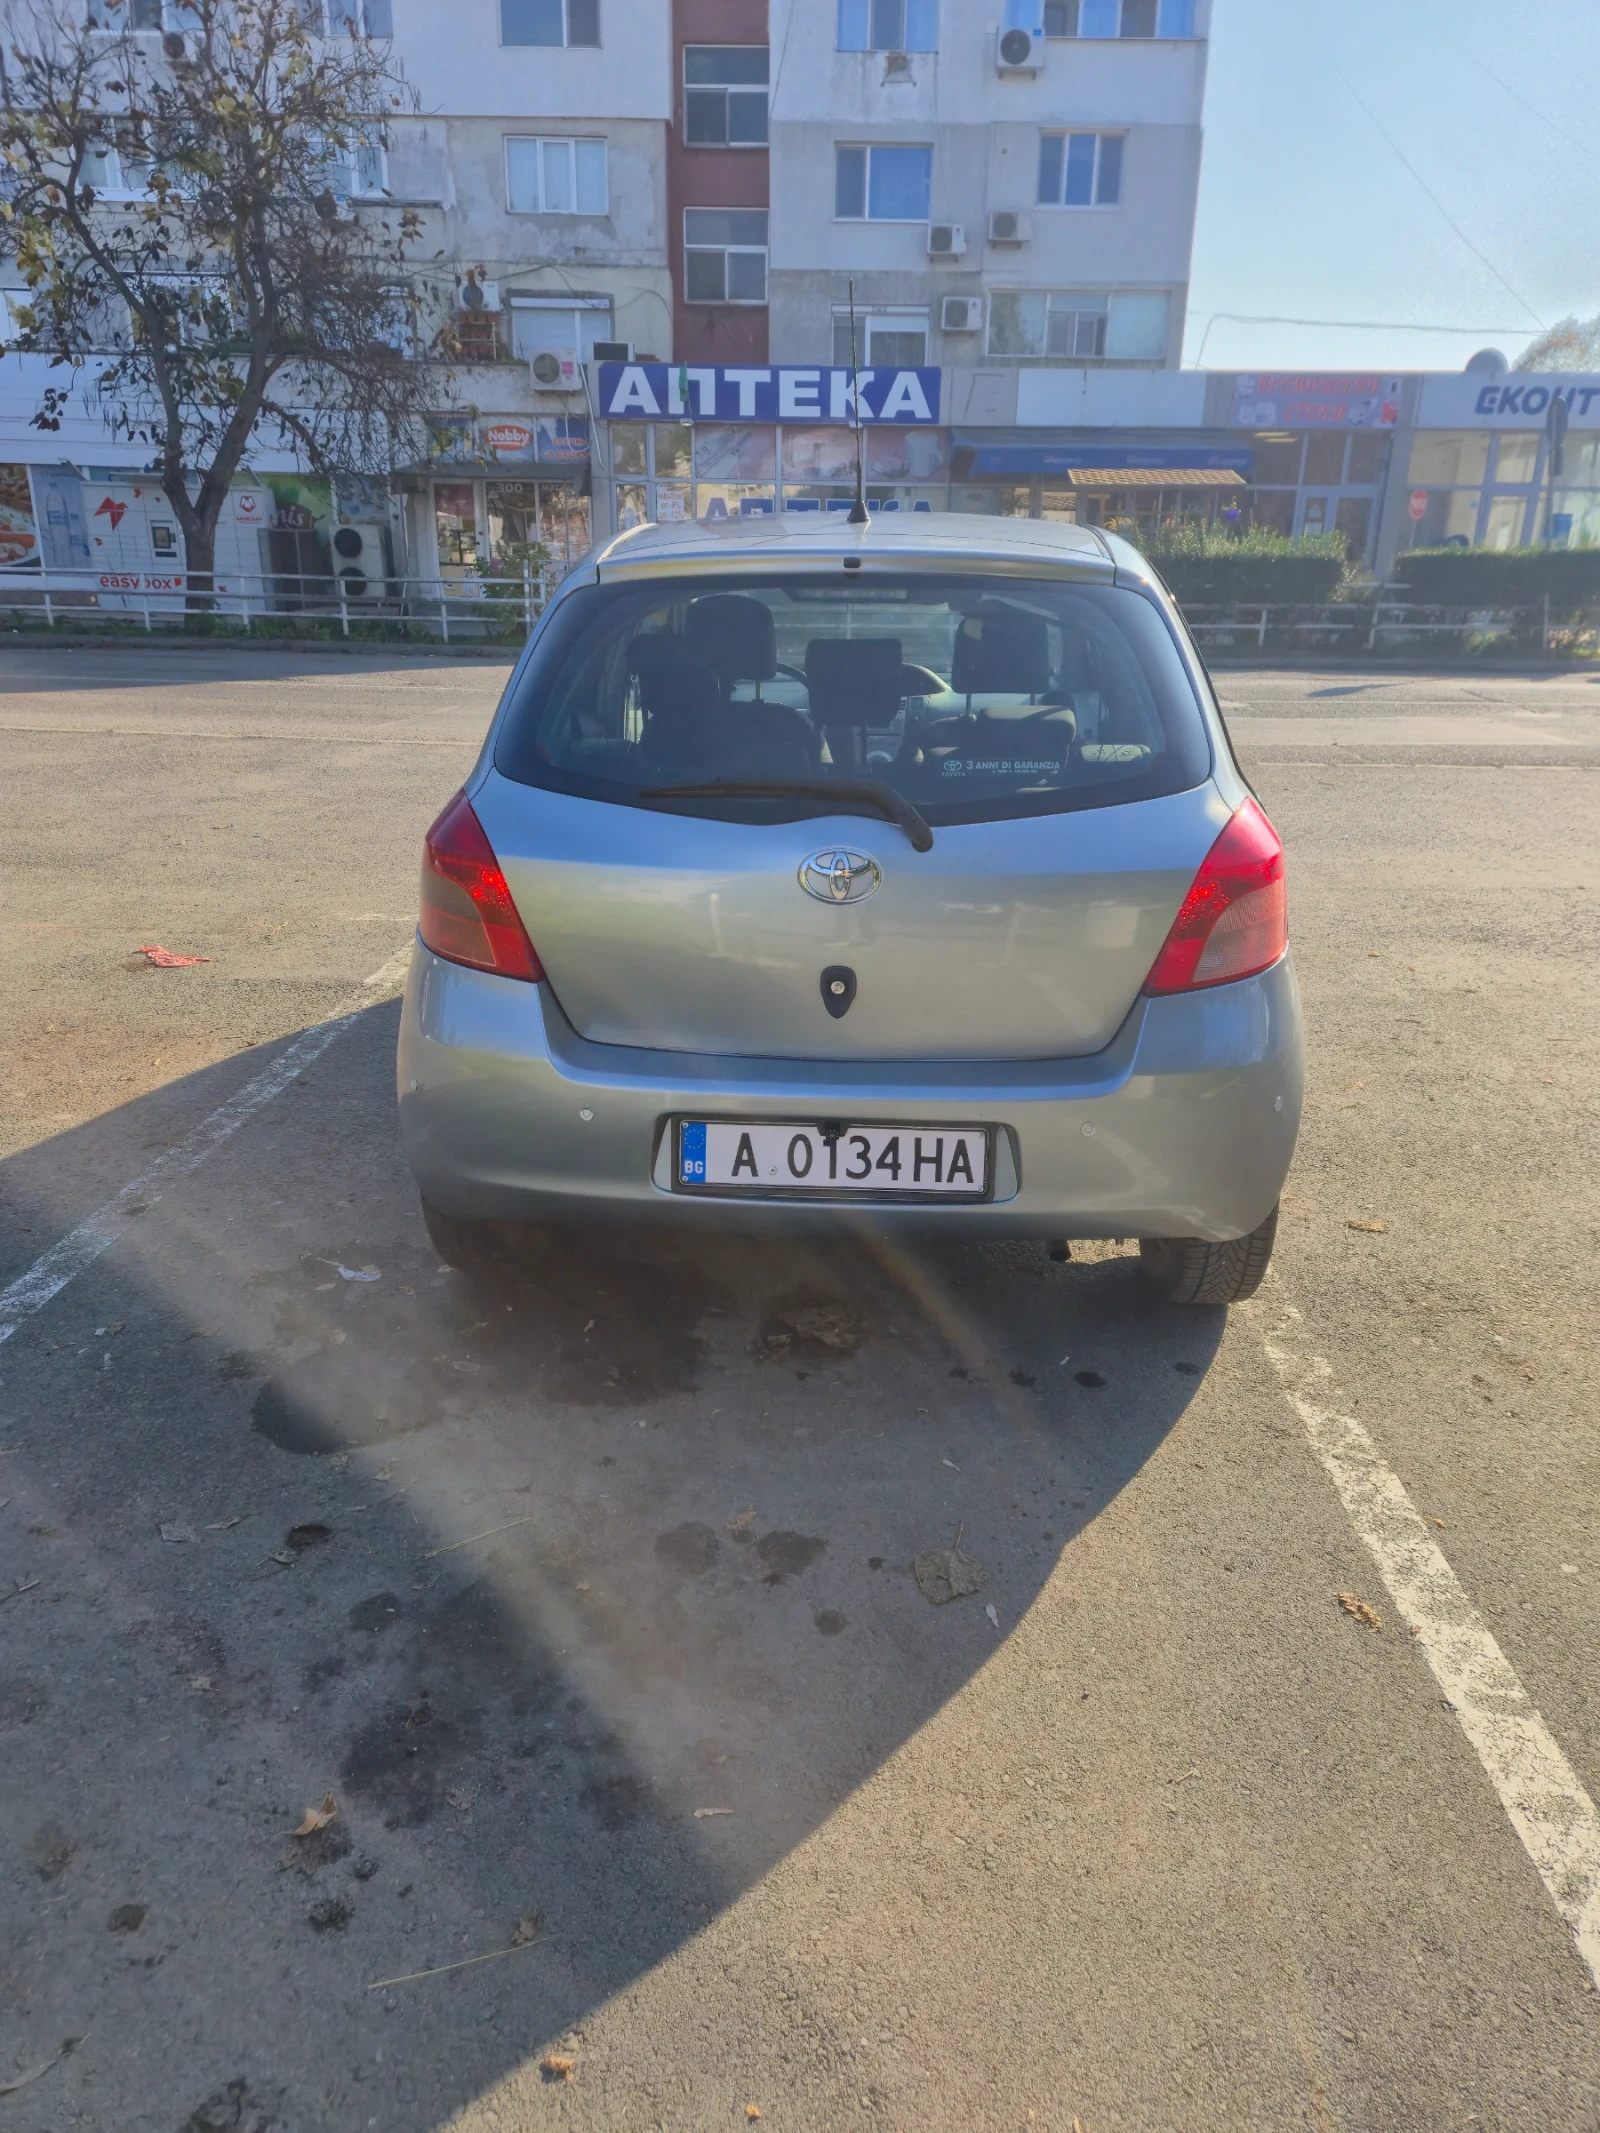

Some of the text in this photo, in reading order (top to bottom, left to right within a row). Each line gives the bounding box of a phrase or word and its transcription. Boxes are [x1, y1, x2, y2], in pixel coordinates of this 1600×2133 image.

[608, 366, 932, 419] АПТЕКА
[487, 428, 530, 447] Nobby
[966, 760, 1060, 770] 3 ANNI DI GARANZIA
[684, 1160, 704, 1175] BG
[731, 1132, 759, 1177] A
